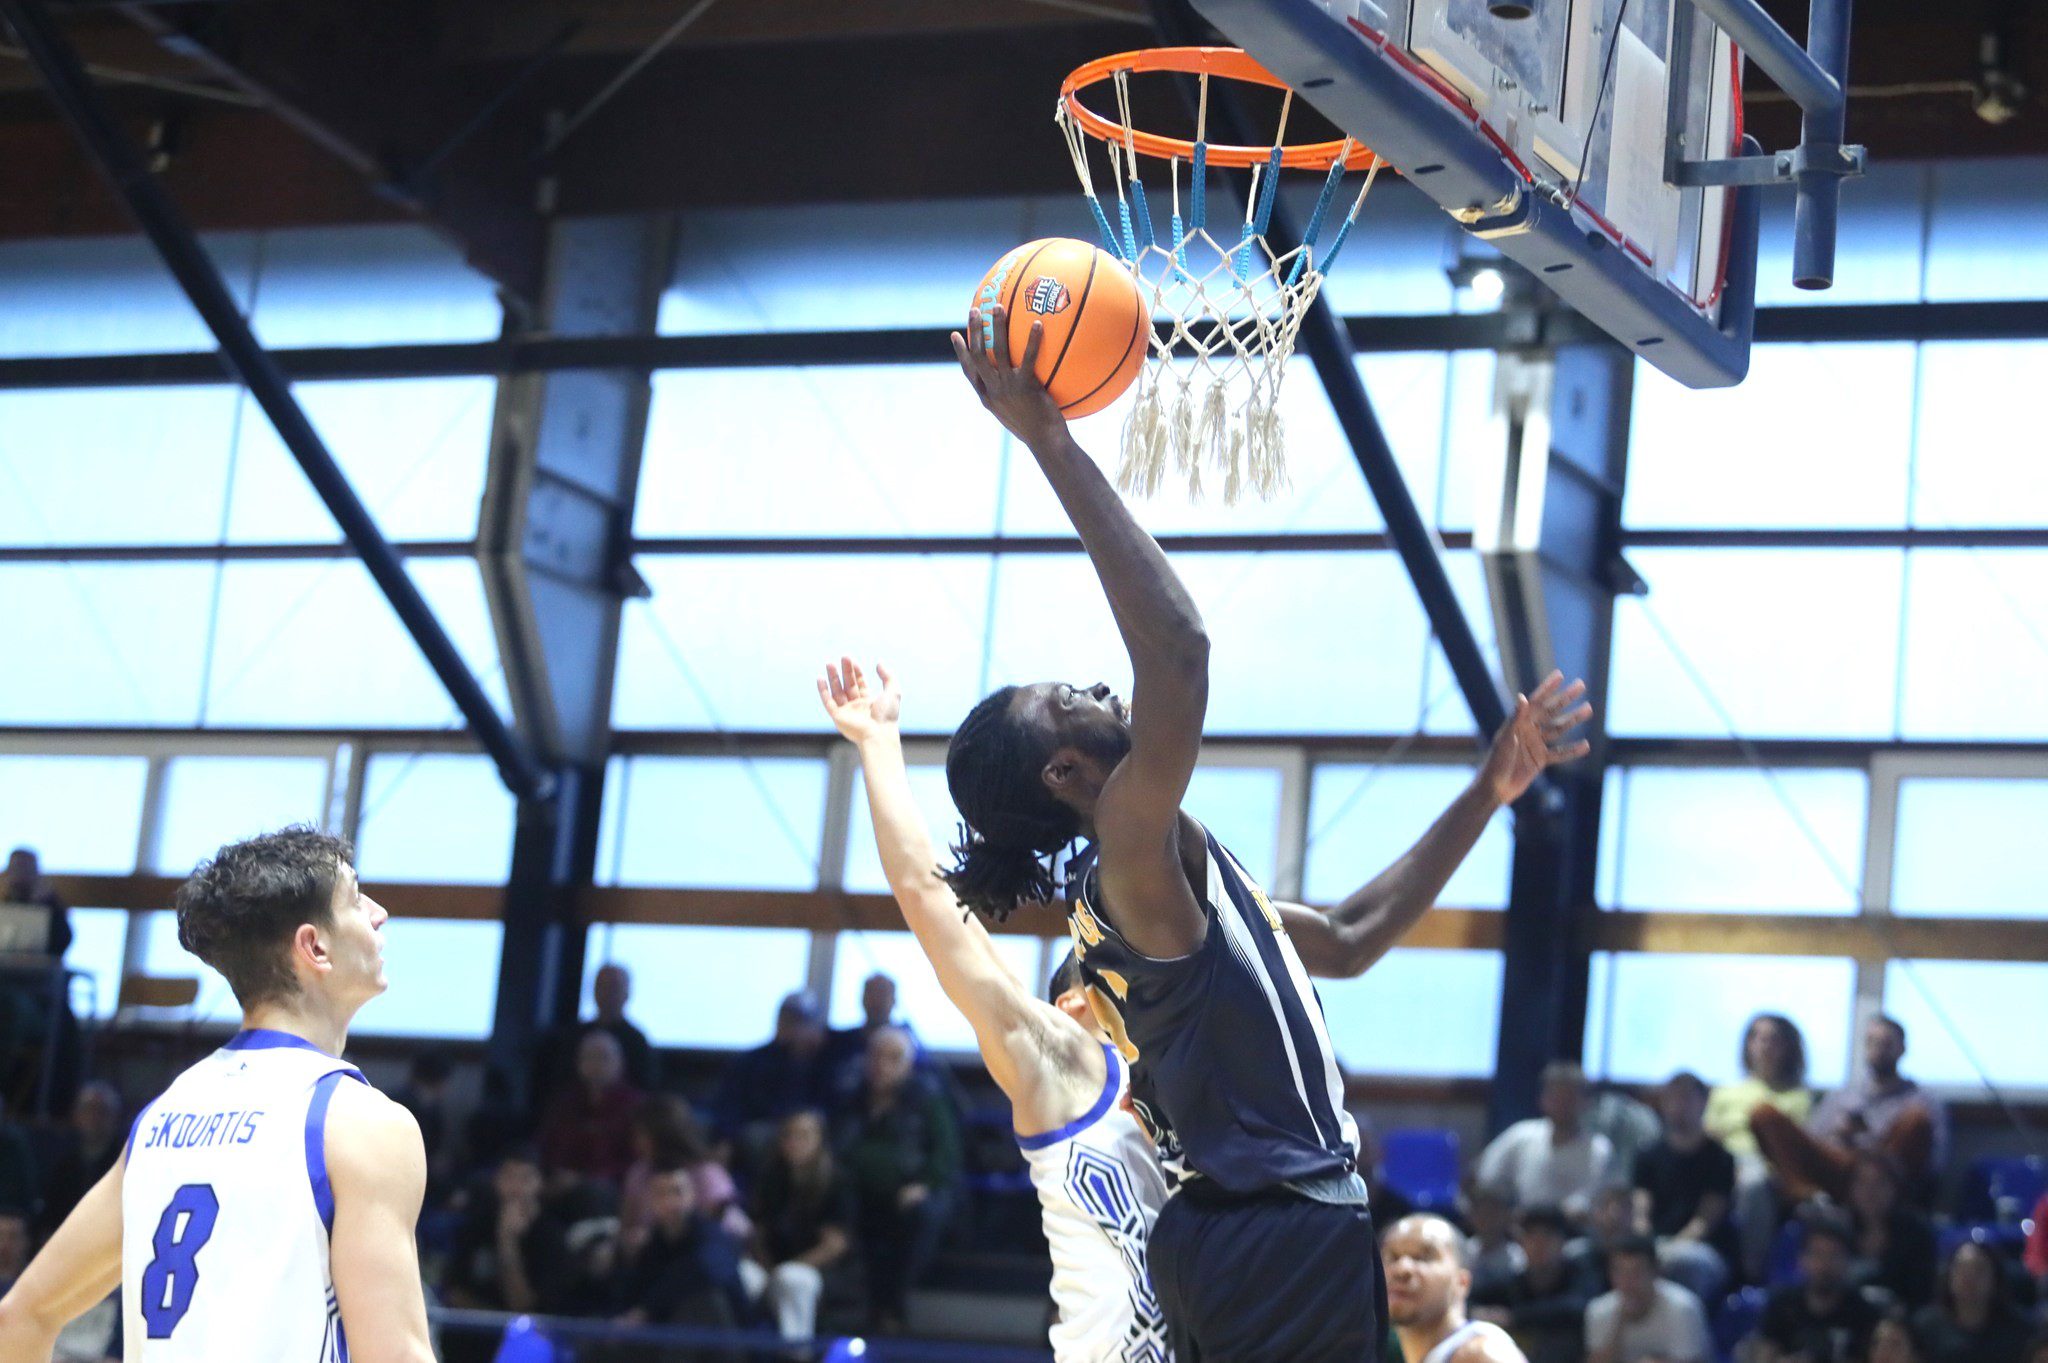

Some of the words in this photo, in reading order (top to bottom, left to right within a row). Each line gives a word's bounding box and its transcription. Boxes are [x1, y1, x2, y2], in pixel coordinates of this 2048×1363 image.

[1031, 279, 1053, 314] ELITE
[1046, 284, 1062, 313] LEAGUE
[145, 1110, 265, 1148] SKOURTIS
[141, 1183, 219, 1339] 8
